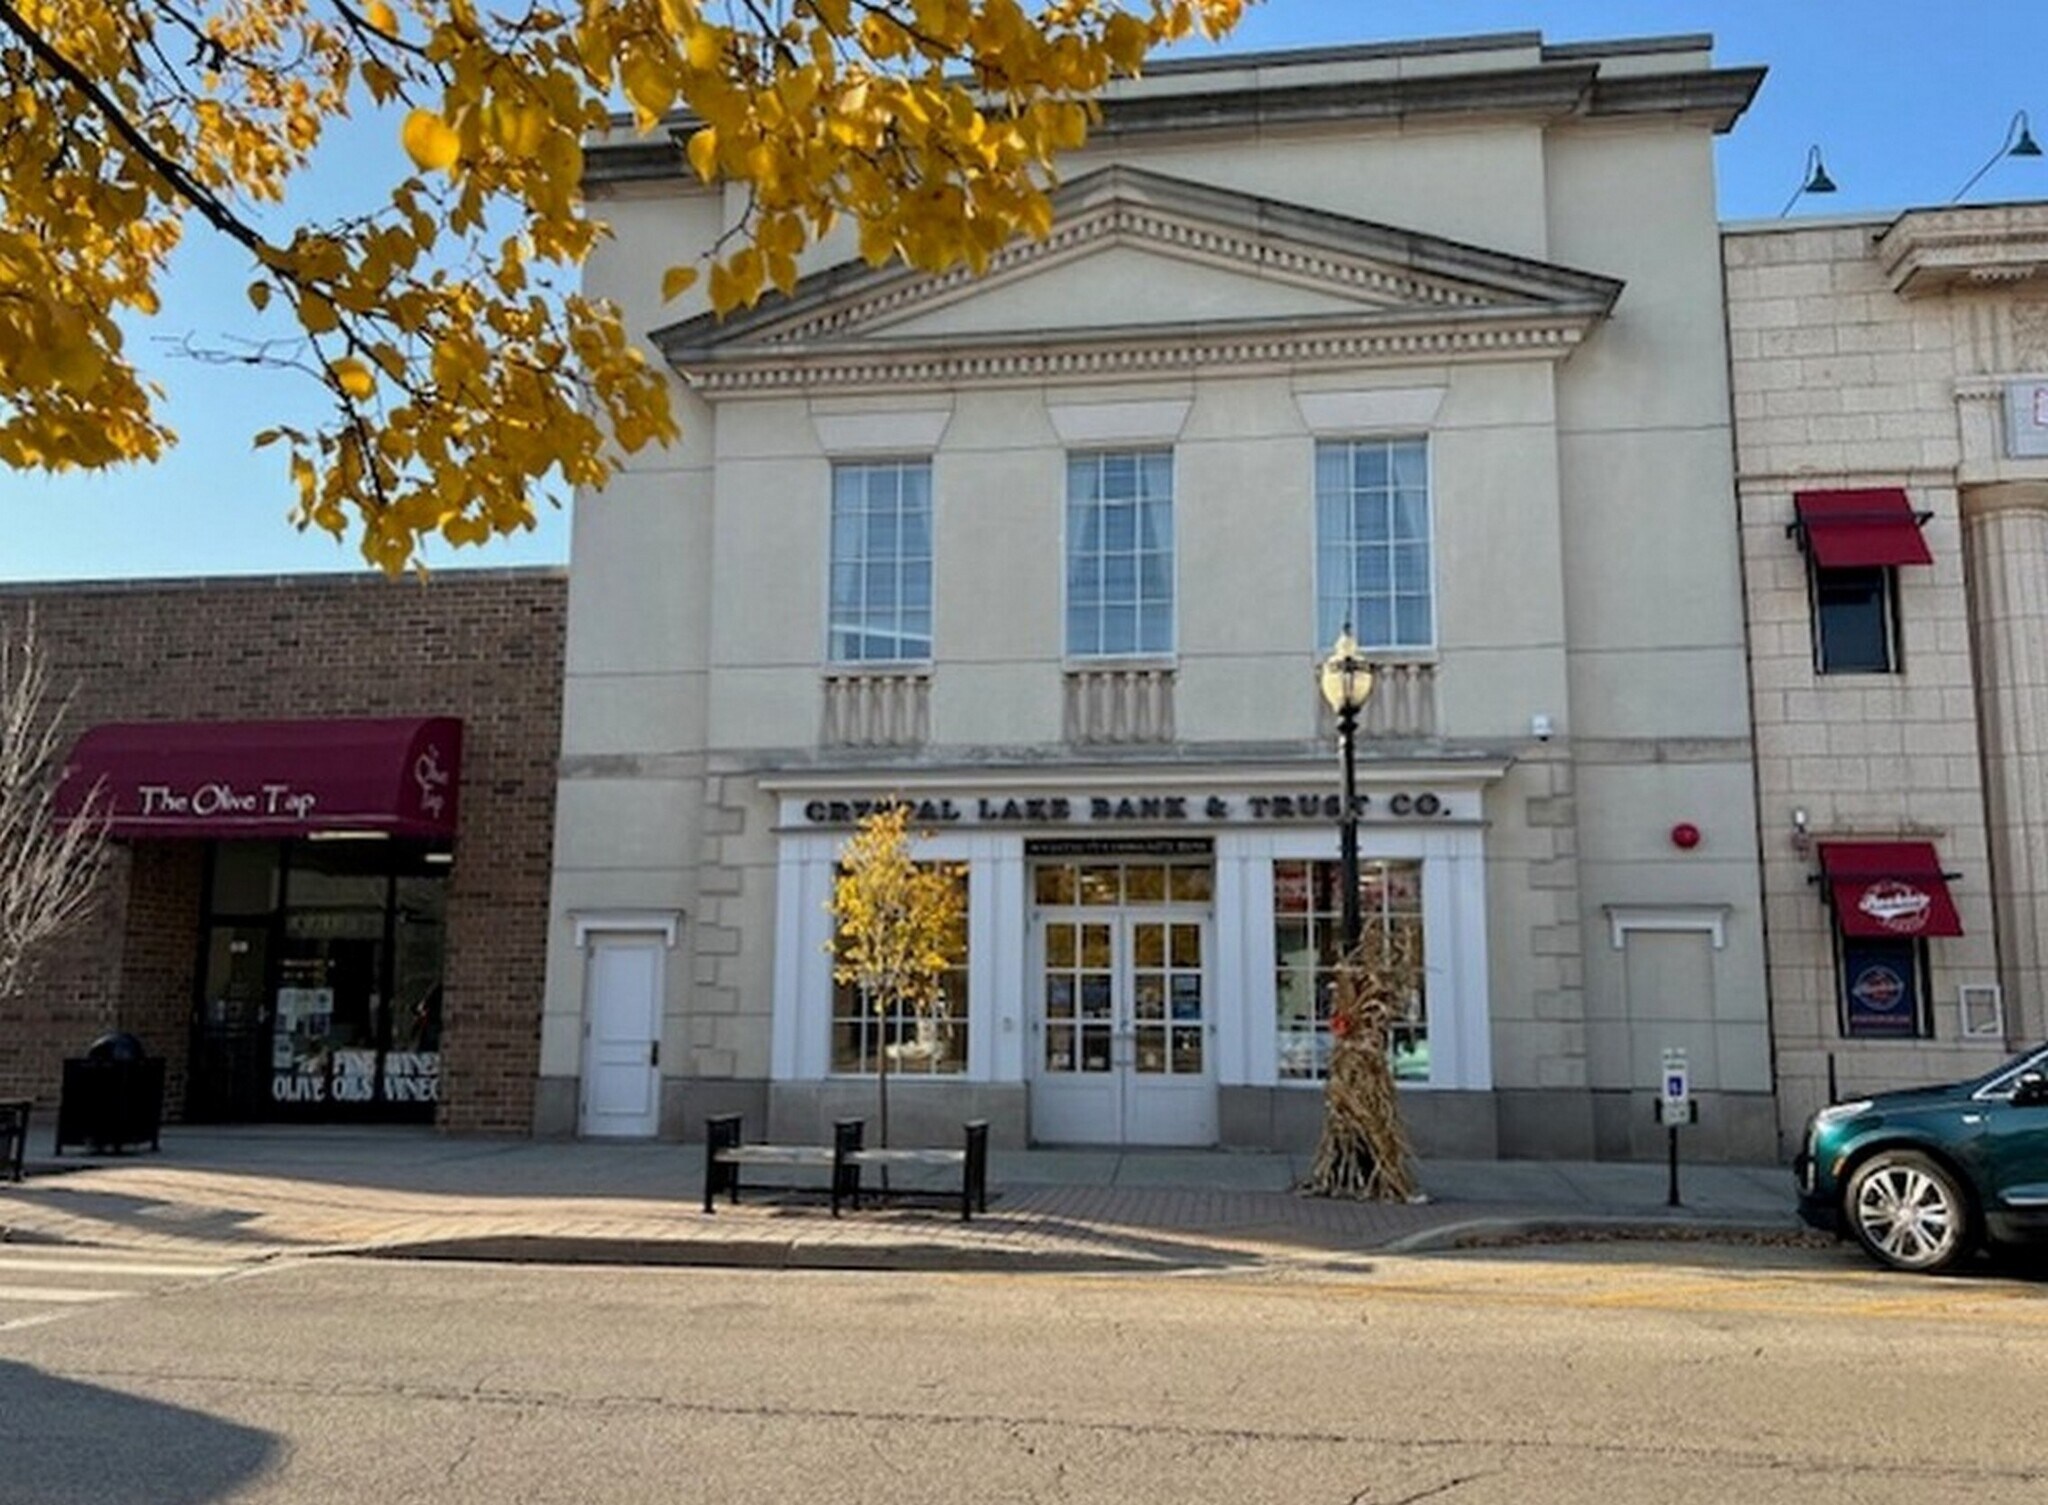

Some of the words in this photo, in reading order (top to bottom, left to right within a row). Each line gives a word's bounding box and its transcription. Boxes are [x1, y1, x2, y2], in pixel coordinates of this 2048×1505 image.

[138, 785, 188, 815] The
[192, 784, 256, 815] Olive
[263, 785, 316, 819] Tap
[978, 798, 1072, 821] LAKE
[1091, 796, 1187, 820] BANK
[1205, 796, 1228, 819] &
[1249, 794, 1370, 818] TRUST
[1390, 793, 1451, 816] CO.
[273, 1076, 325, 1101] OLIVE
[331, 1076, 374, 1101] OILS
